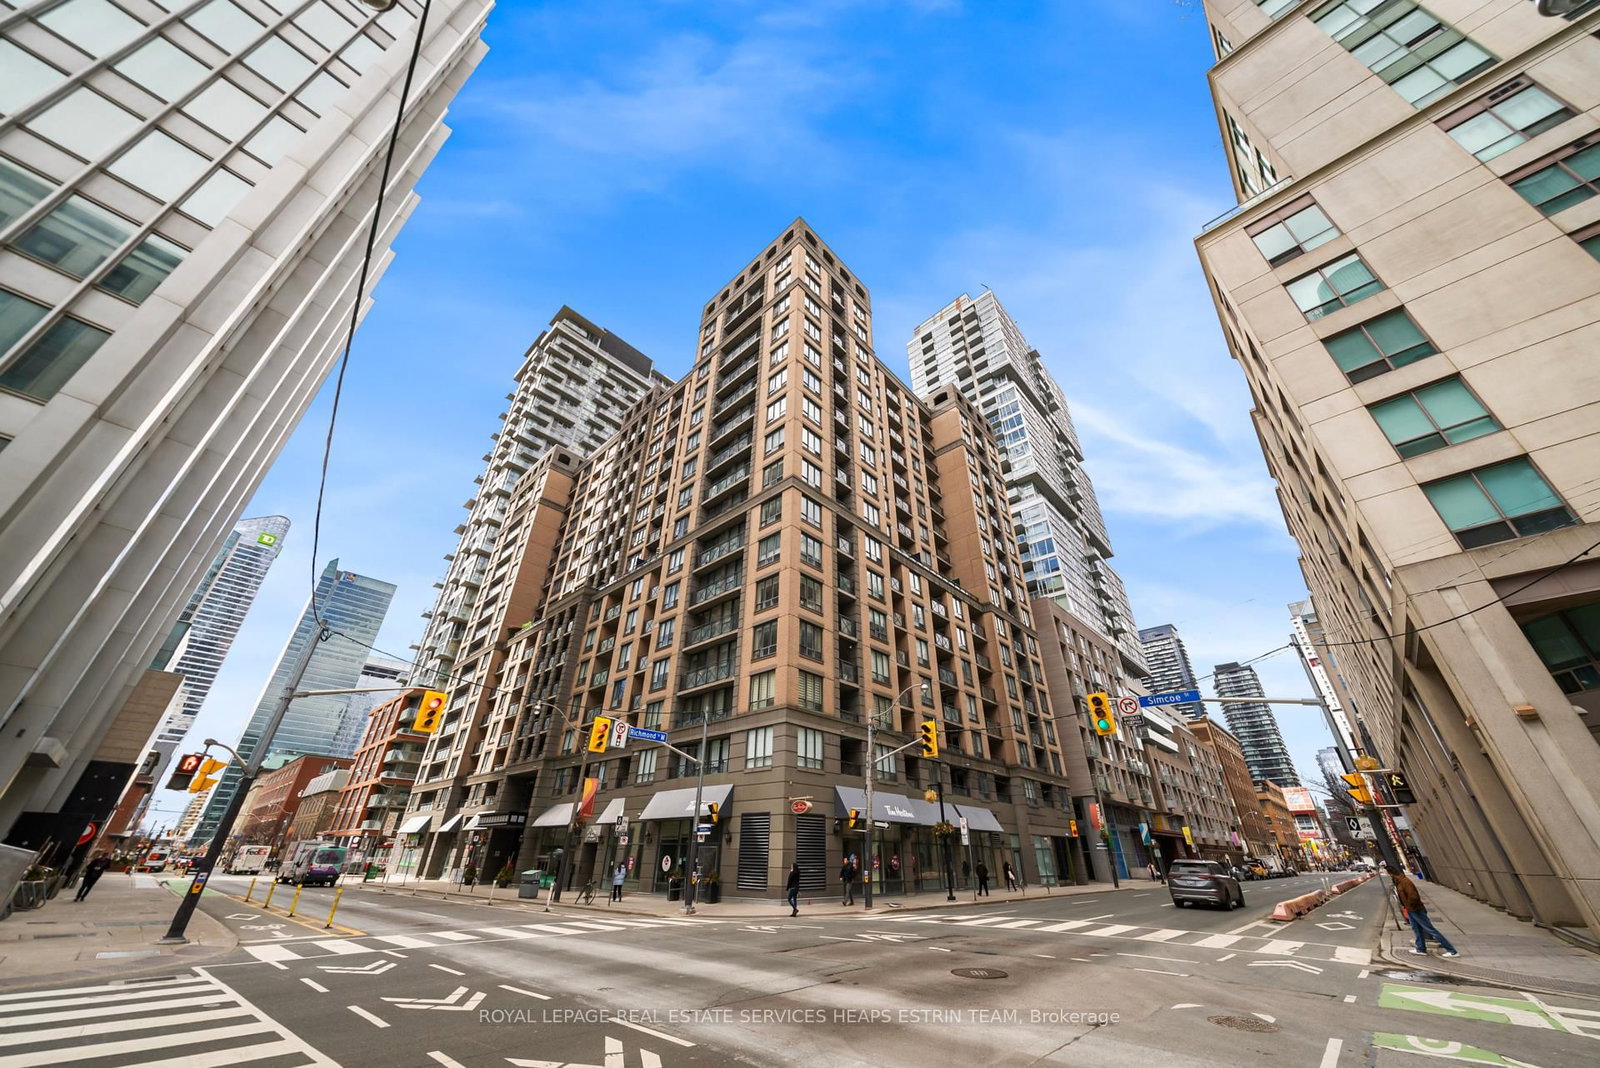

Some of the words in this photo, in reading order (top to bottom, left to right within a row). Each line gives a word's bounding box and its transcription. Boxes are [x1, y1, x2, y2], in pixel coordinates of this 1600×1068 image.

[1147, 693, 1182, 705] Simcoe
[630, 728, 657, 739] Richmond
[883, 805, 896, 816] Tim
[894, 805, 915, 818] Hortons
